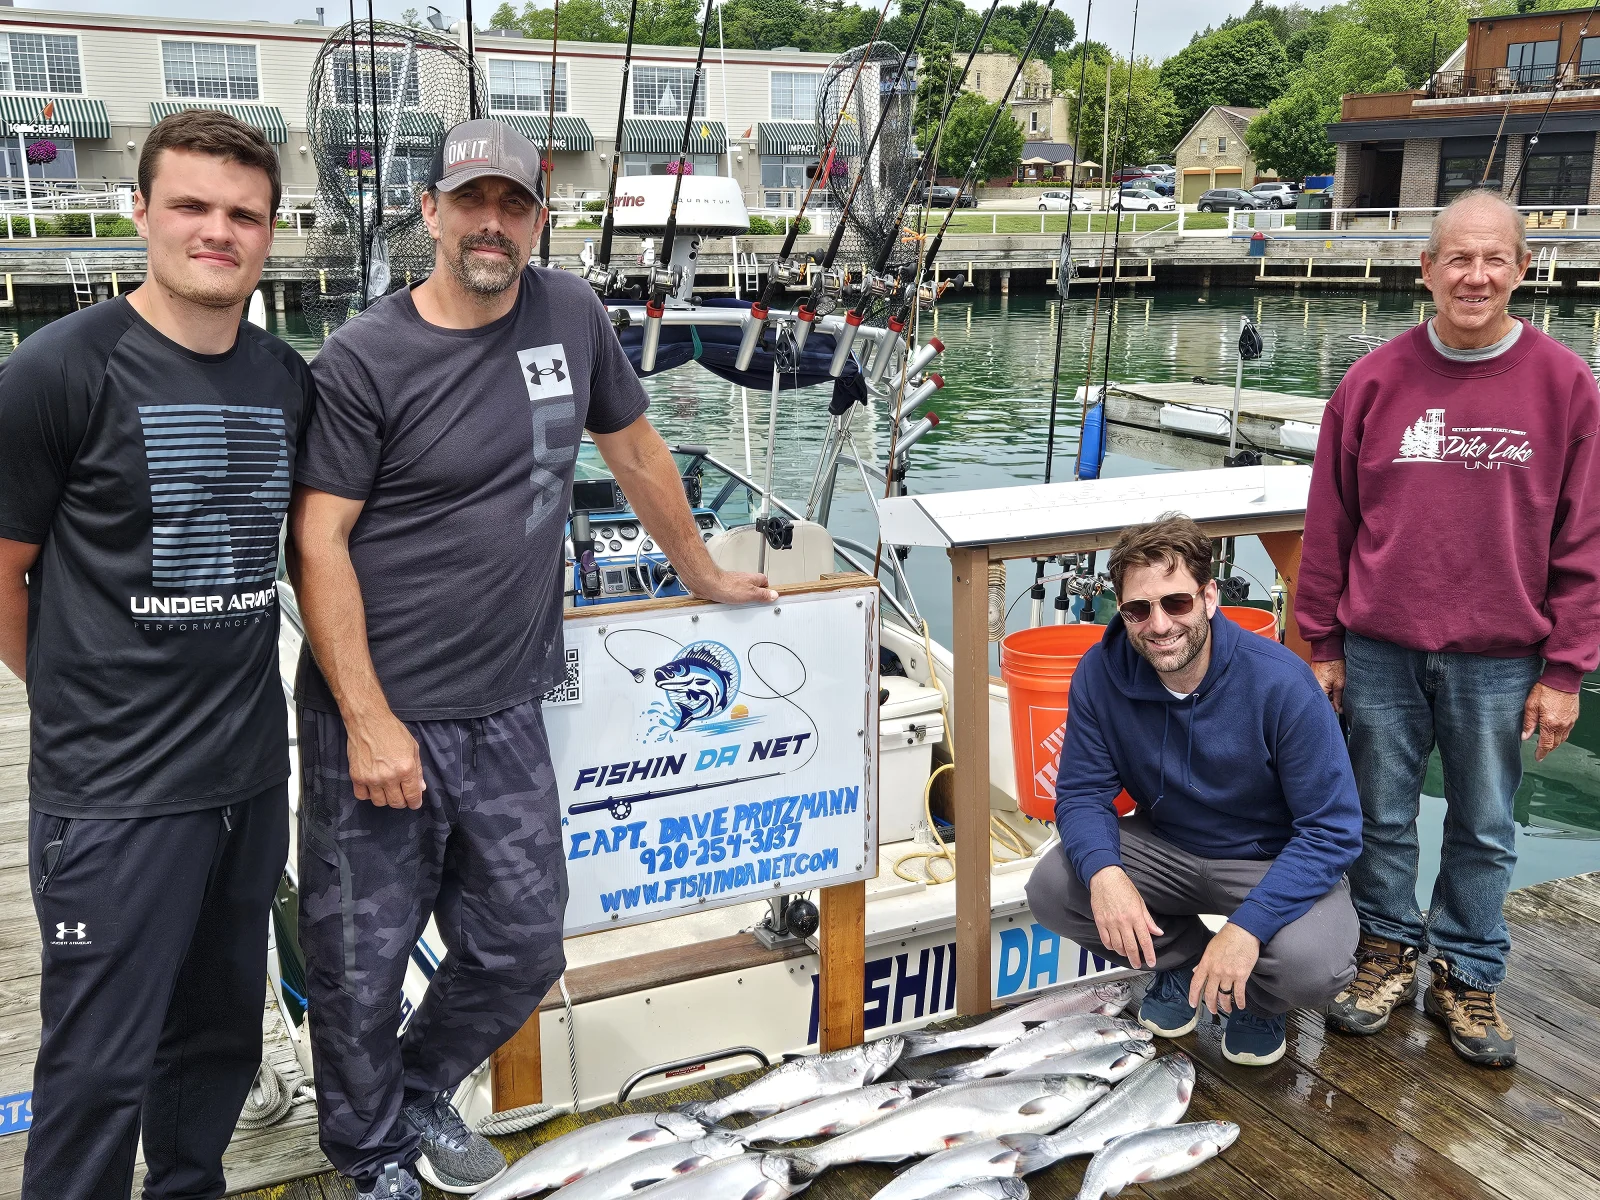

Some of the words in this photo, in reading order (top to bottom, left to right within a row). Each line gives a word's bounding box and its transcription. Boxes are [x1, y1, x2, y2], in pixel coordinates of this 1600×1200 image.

[471, 140, 489, 159] IT.
[788, 144, 816, 153] IMPACT
[1440, 436, 1490, 459] Pike
[1488, 437, 1535, 463] Lake
[1464, 461, 1502, 470] UNIT
[130, 595, 223, 614] UNDER
[134, 619, 248, 632] PERFORMANCE
[573, 752, 688, 791] FISHIN
[694, 744, 742, 772] DA
[747, 732, 812, 763] NET
[567, 821, 648, 860] CAPT.
[658, 806, 730, 845] DAVE
[731, 785, 860, 834] PROTZMANN
[639, 822, 802, 875] 920-254-3137
[996, 923, 1061, 998] DA
